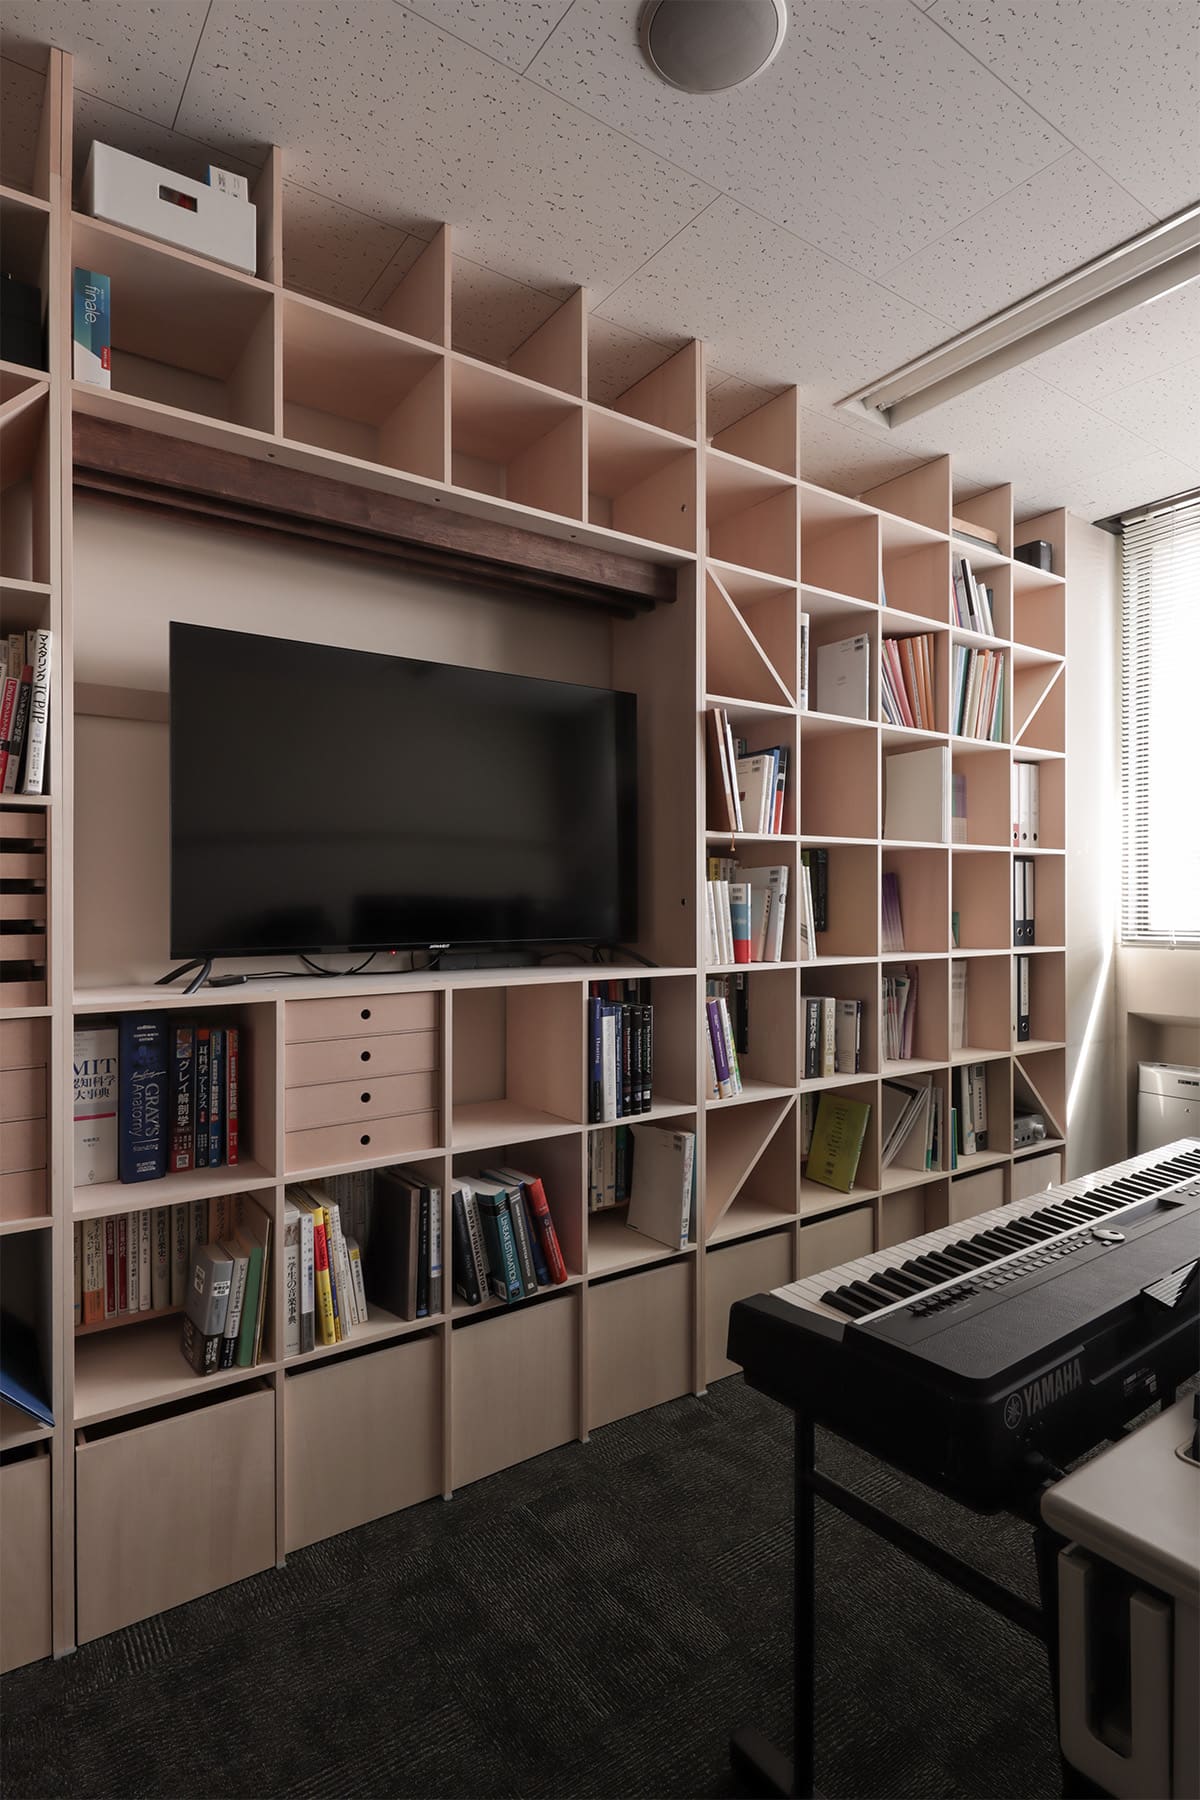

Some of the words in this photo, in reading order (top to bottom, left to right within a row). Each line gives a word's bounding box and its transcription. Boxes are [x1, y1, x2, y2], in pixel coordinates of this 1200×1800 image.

[74, 1058, 116, 1075] MIT
[177, 1060, 190, 1127] グレイ解剖学
[129, 1084, 144, 1138] Anatomy
[145, 1083, 160, 1138] GRAY'S
[467, 1209, 475, 1229] DATA
[471, 1231, 486, 1292] VISUALIZATION
[500, 1215, 511, 1242] LINEAR
[504, 1241, 517, 1283] ESTIMATION
[286, 1262, 297, 1326] 学生の音楽事典
[1022, 1358, 1084, 1418] YAMAHA
